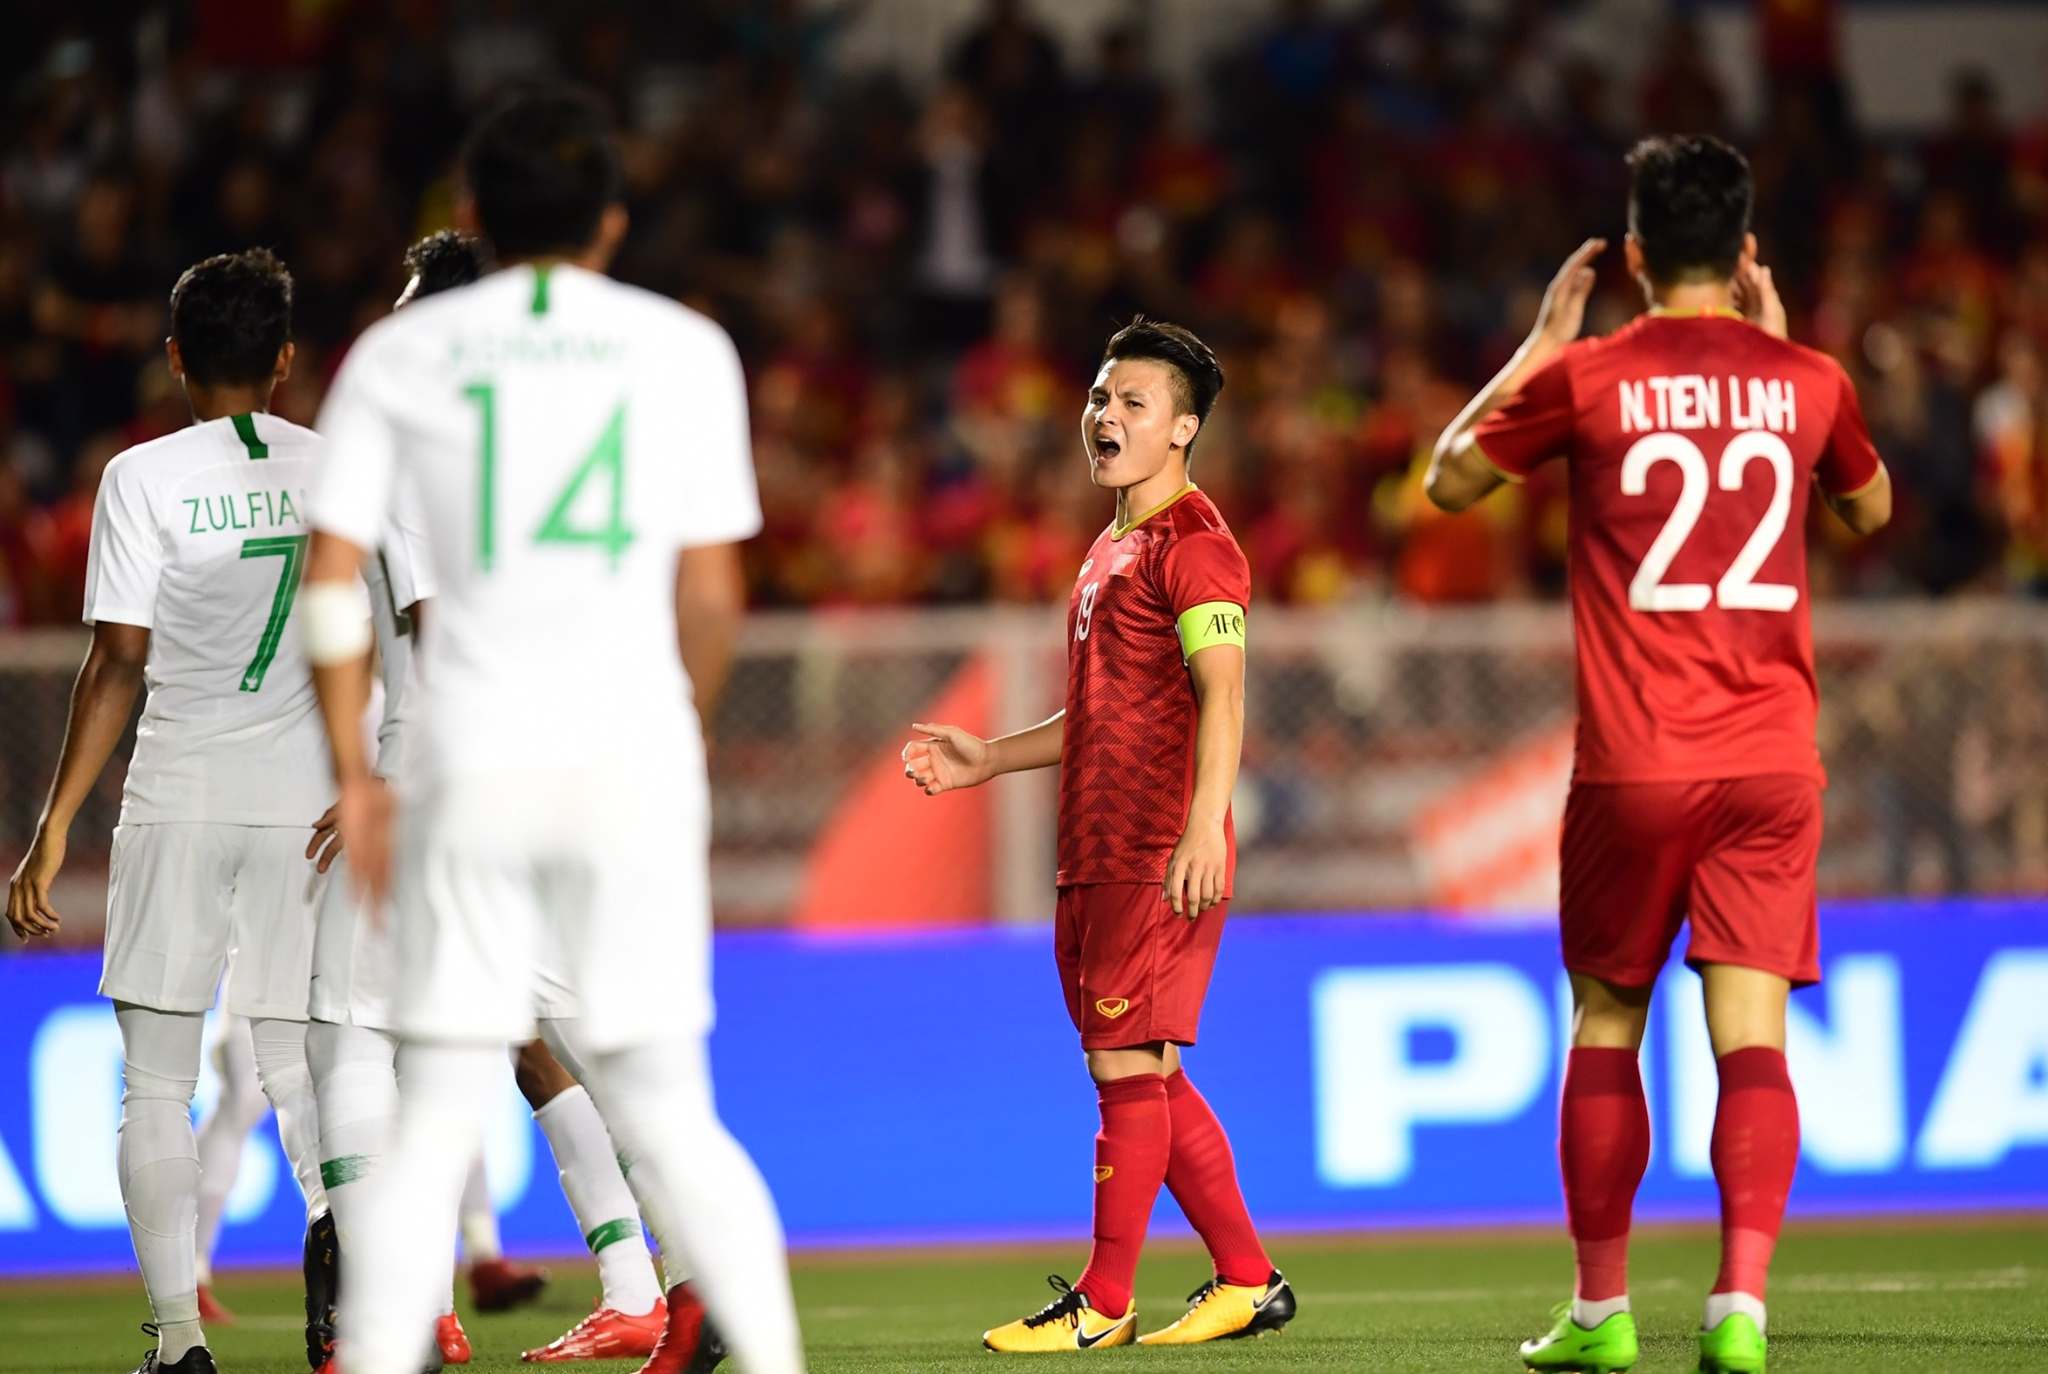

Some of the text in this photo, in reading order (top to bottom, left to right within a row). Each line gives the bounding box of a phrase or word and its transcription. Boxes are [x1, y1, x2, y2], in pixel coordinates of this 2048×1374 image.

[461, 380, 638, 575] 14
[1618, 374, 1797, 434] N.TIEN LINH
[1620, 431, 1799, 612] 22
[239, 536, 308, 694] 7
[1074, 581, 1099, 642] 19
